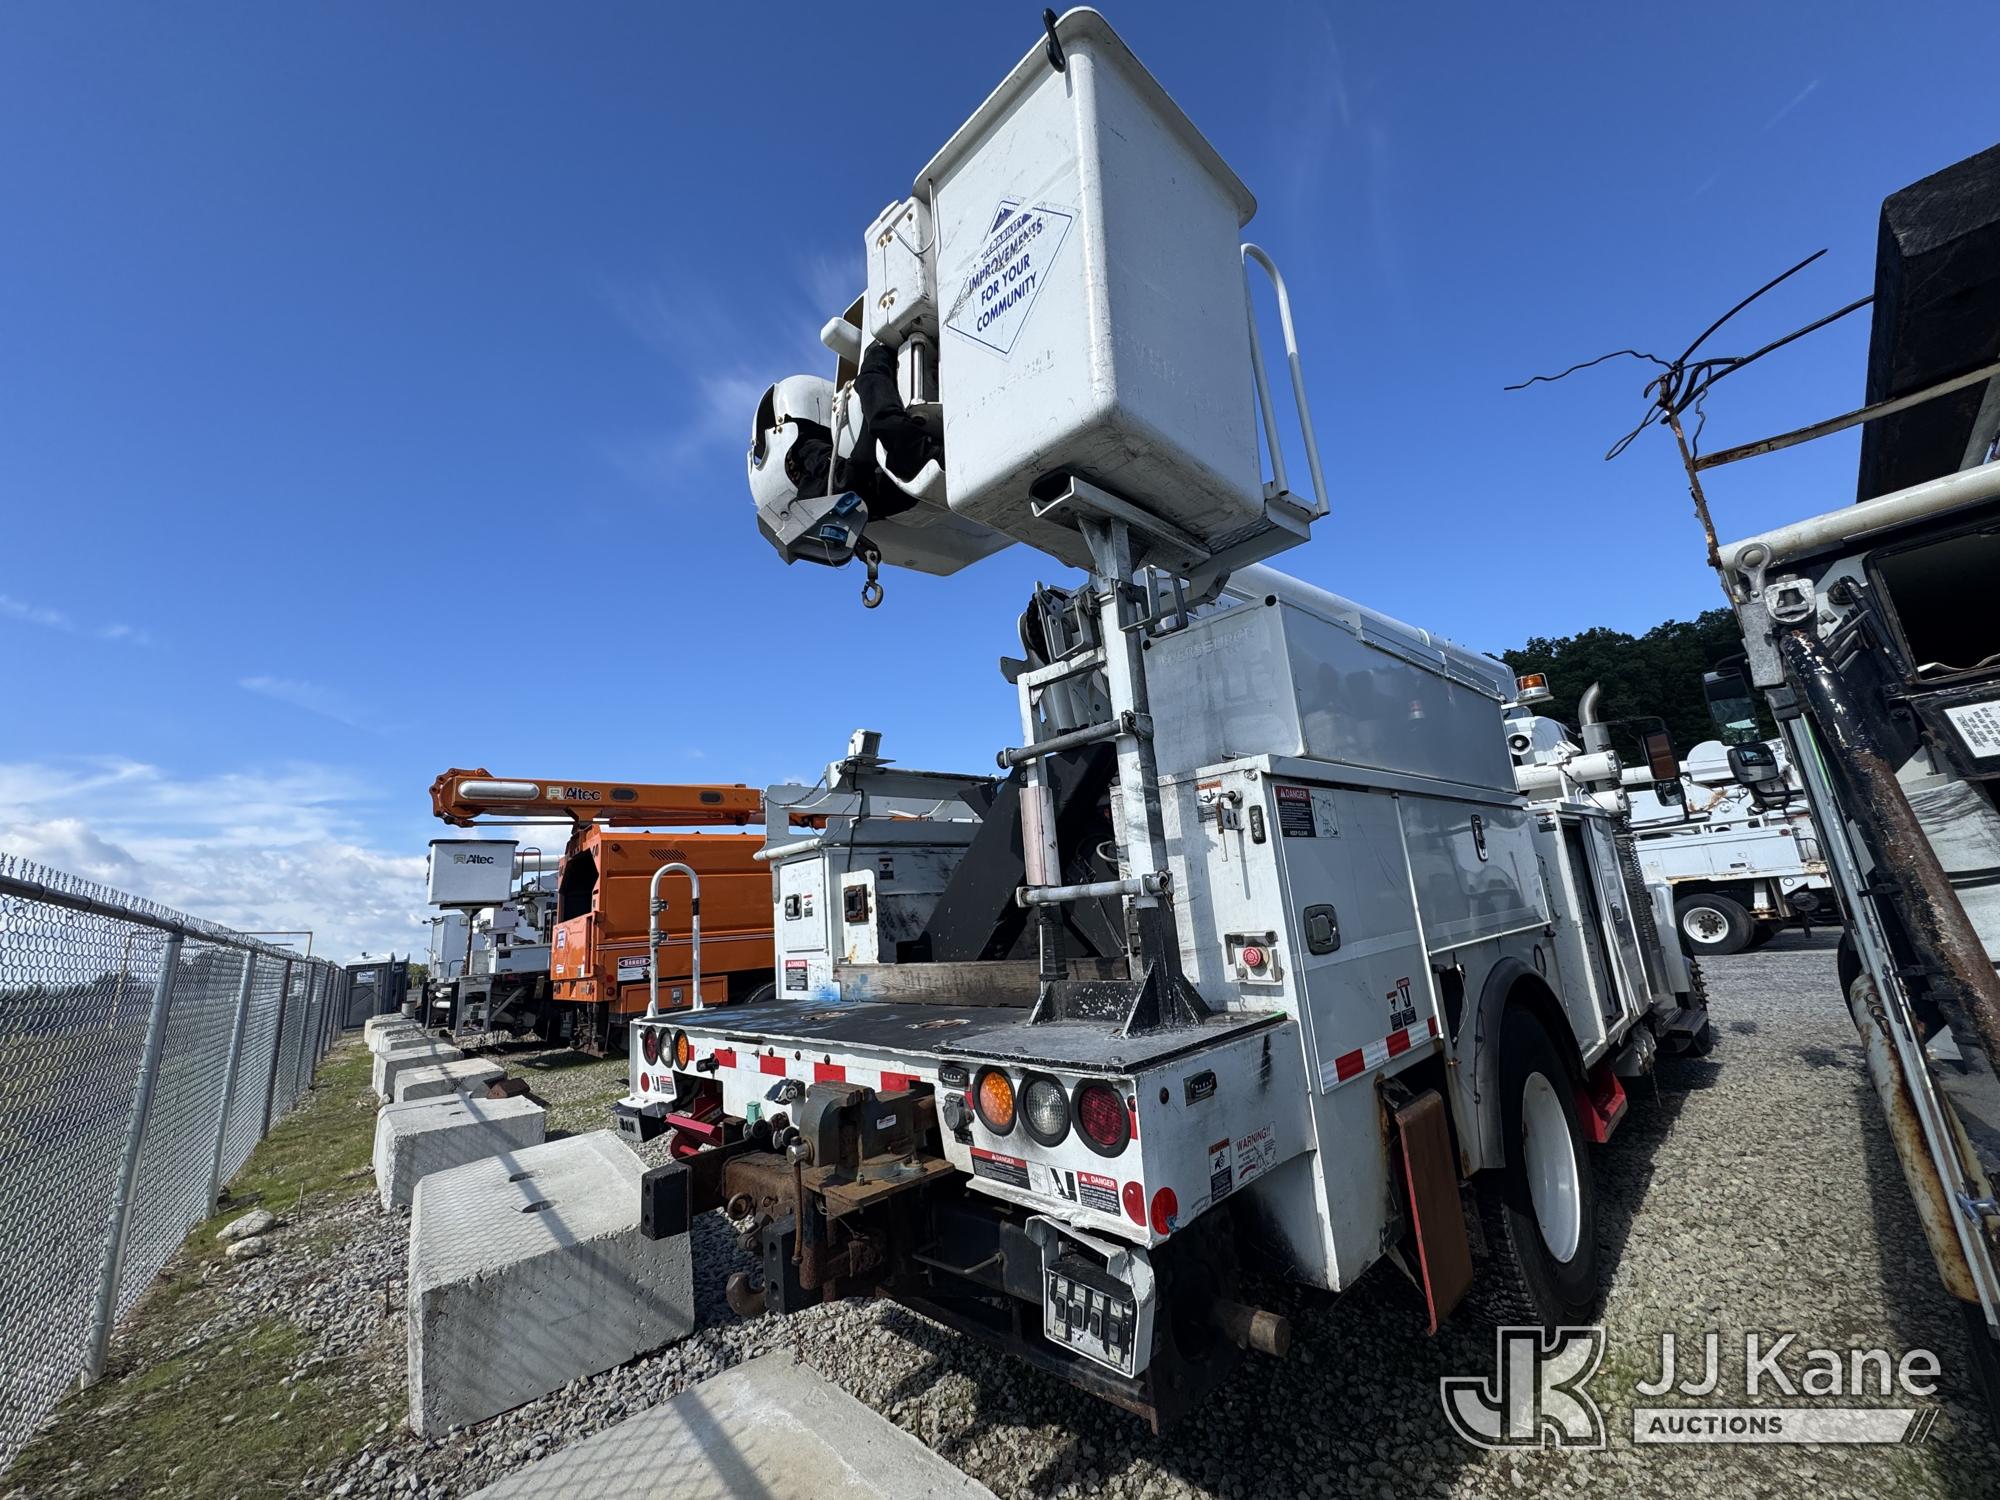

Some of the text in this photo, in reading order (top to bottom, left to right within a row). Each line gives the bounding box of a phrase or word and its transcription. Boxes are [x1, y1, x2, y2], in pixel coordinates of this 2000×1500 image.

[981, 253, 1031, 306] FOR YOUR
[976, 271, 1038, 332] COMMUNITY
[564, 787, 601, 800] Altec
[1285, 788, 1307, 799] DANGER
[465, 854, 495, 864] Altec
[1236, 1126, 1271, 1152] WARNING!!
[996, 1155, 1015, 1165] DANGER
[1090, 1175, 1115, 1188] DANGER
